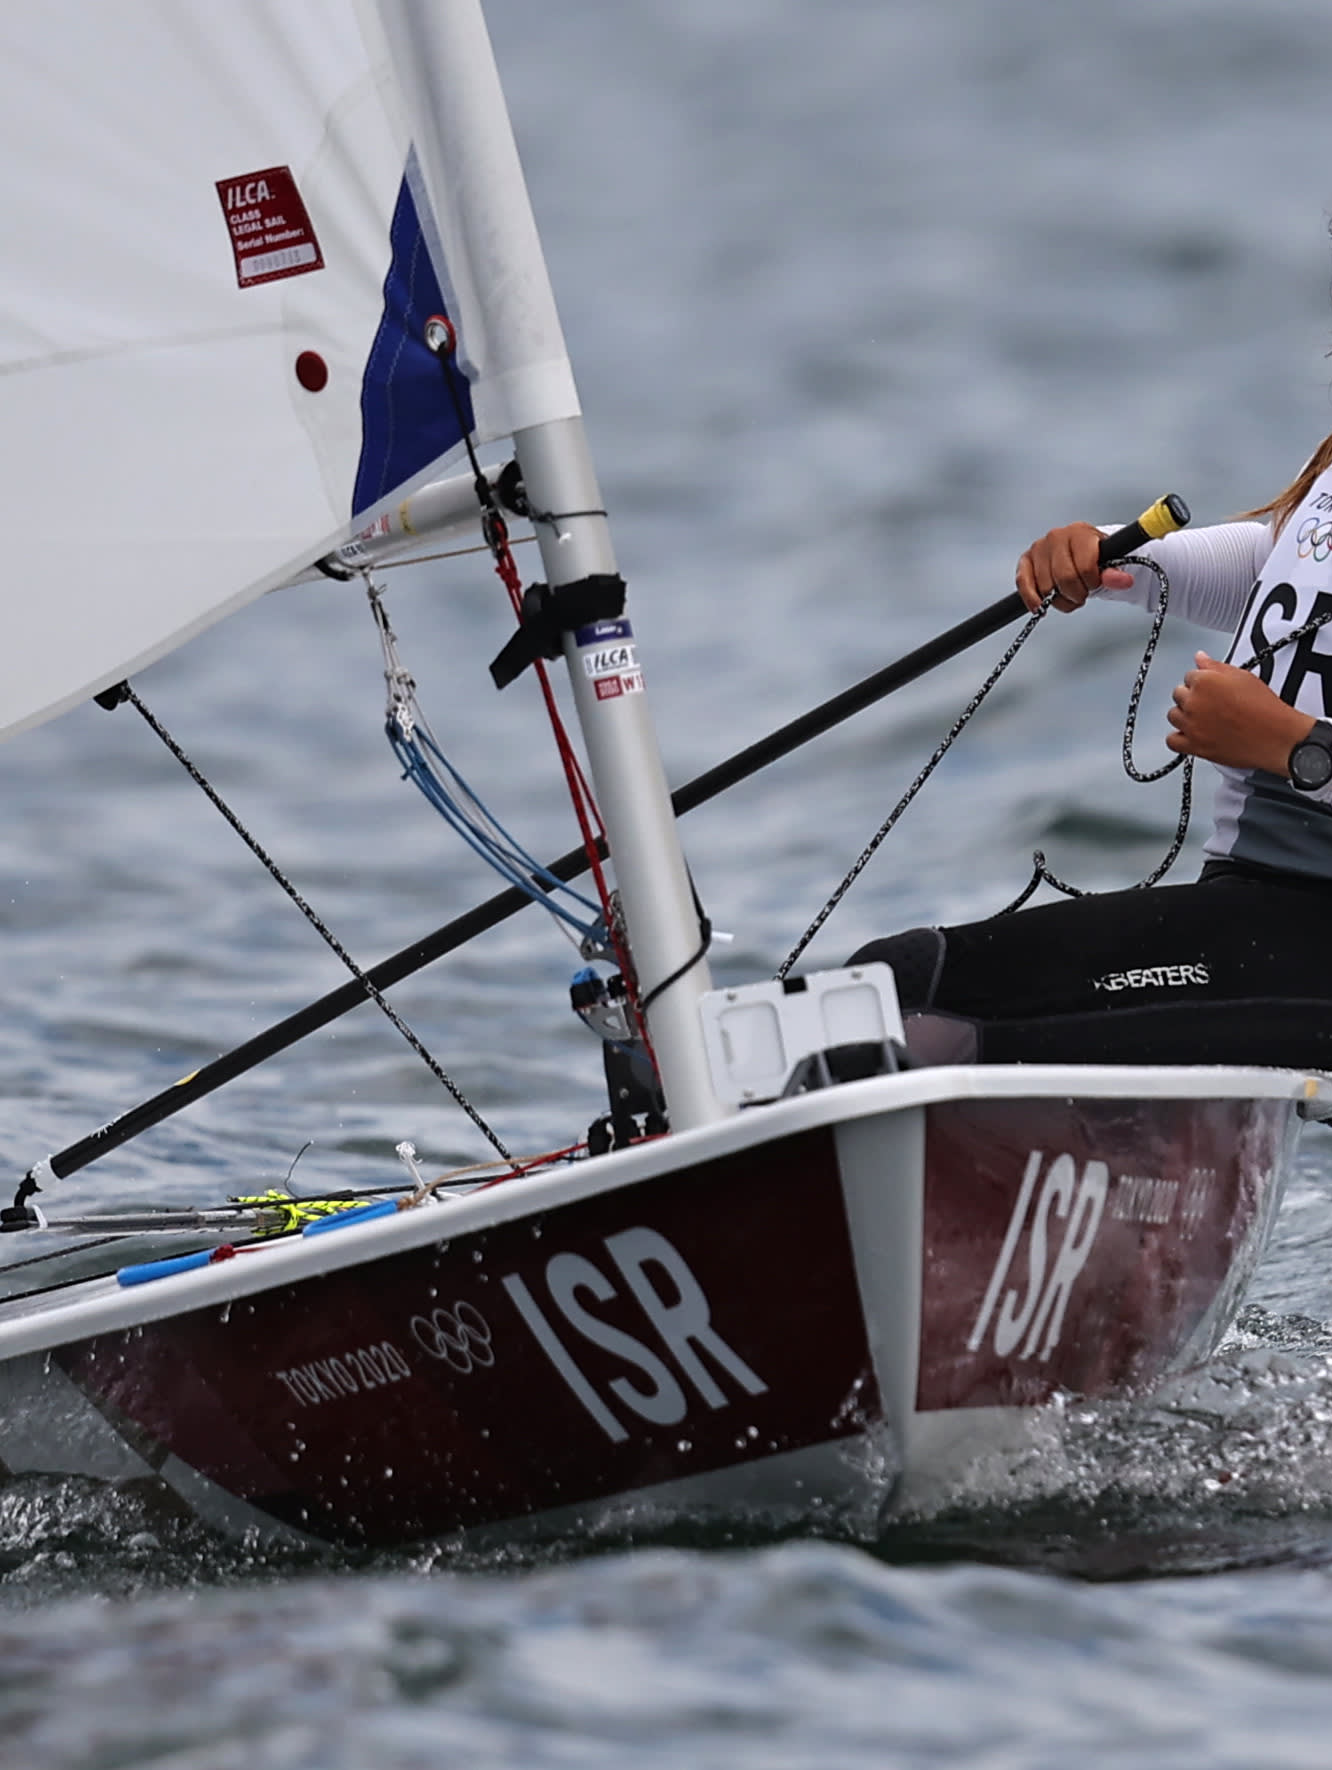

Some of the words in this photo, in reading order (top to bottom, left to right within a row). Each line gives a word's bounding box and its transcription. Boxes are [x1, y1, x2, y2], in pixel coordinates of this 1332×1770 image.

[229, 208, 262, 225] CLASS
[232, 220, 264, 236] LEGAL
[264, 214, 288, 229] SAIL
[236, 235, 265, 251] Serial
[594, 648, 629, 670] ILCA
[966, 1150, 1110, 1362] ISR
[501, 1226, 769, 1444] ISR
[275, 1356, 360, 1408] TOKYO
[344, 1340, 412, 1389] 2020
